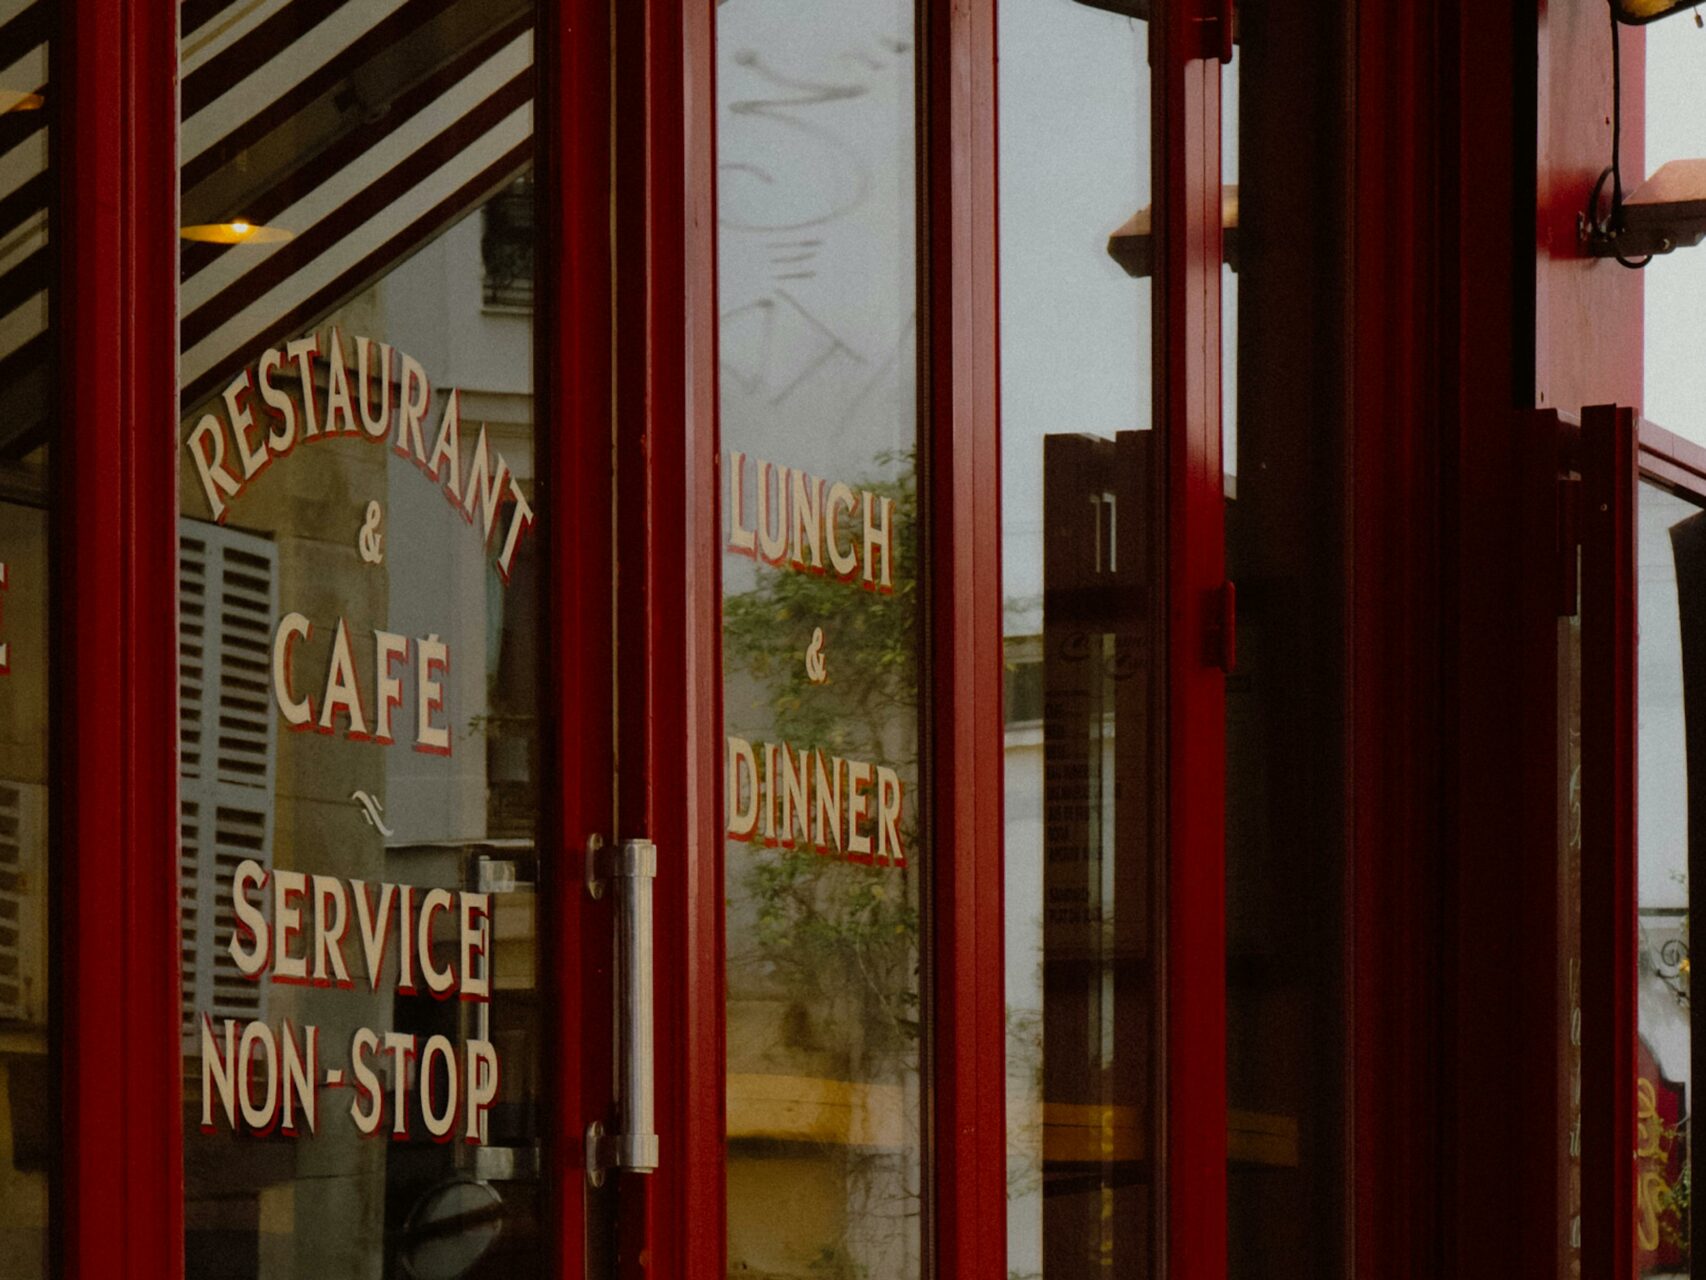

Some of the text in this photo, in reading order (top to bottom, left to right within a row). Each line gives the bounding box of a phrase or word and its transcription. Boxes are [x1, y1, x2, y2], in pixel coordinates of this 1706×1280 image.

[186, 325, 534, 586] RESTAURANT
[727, 451, 894, 595] LUNCH
[358, 499, 384, 565] &
[805, 626, 828, 685] &
[726, 735, 907, 868] DINNER
[228, 858, 491, 1002] SERVICE
[200, 1011, 499, 1146] NON-STOP
